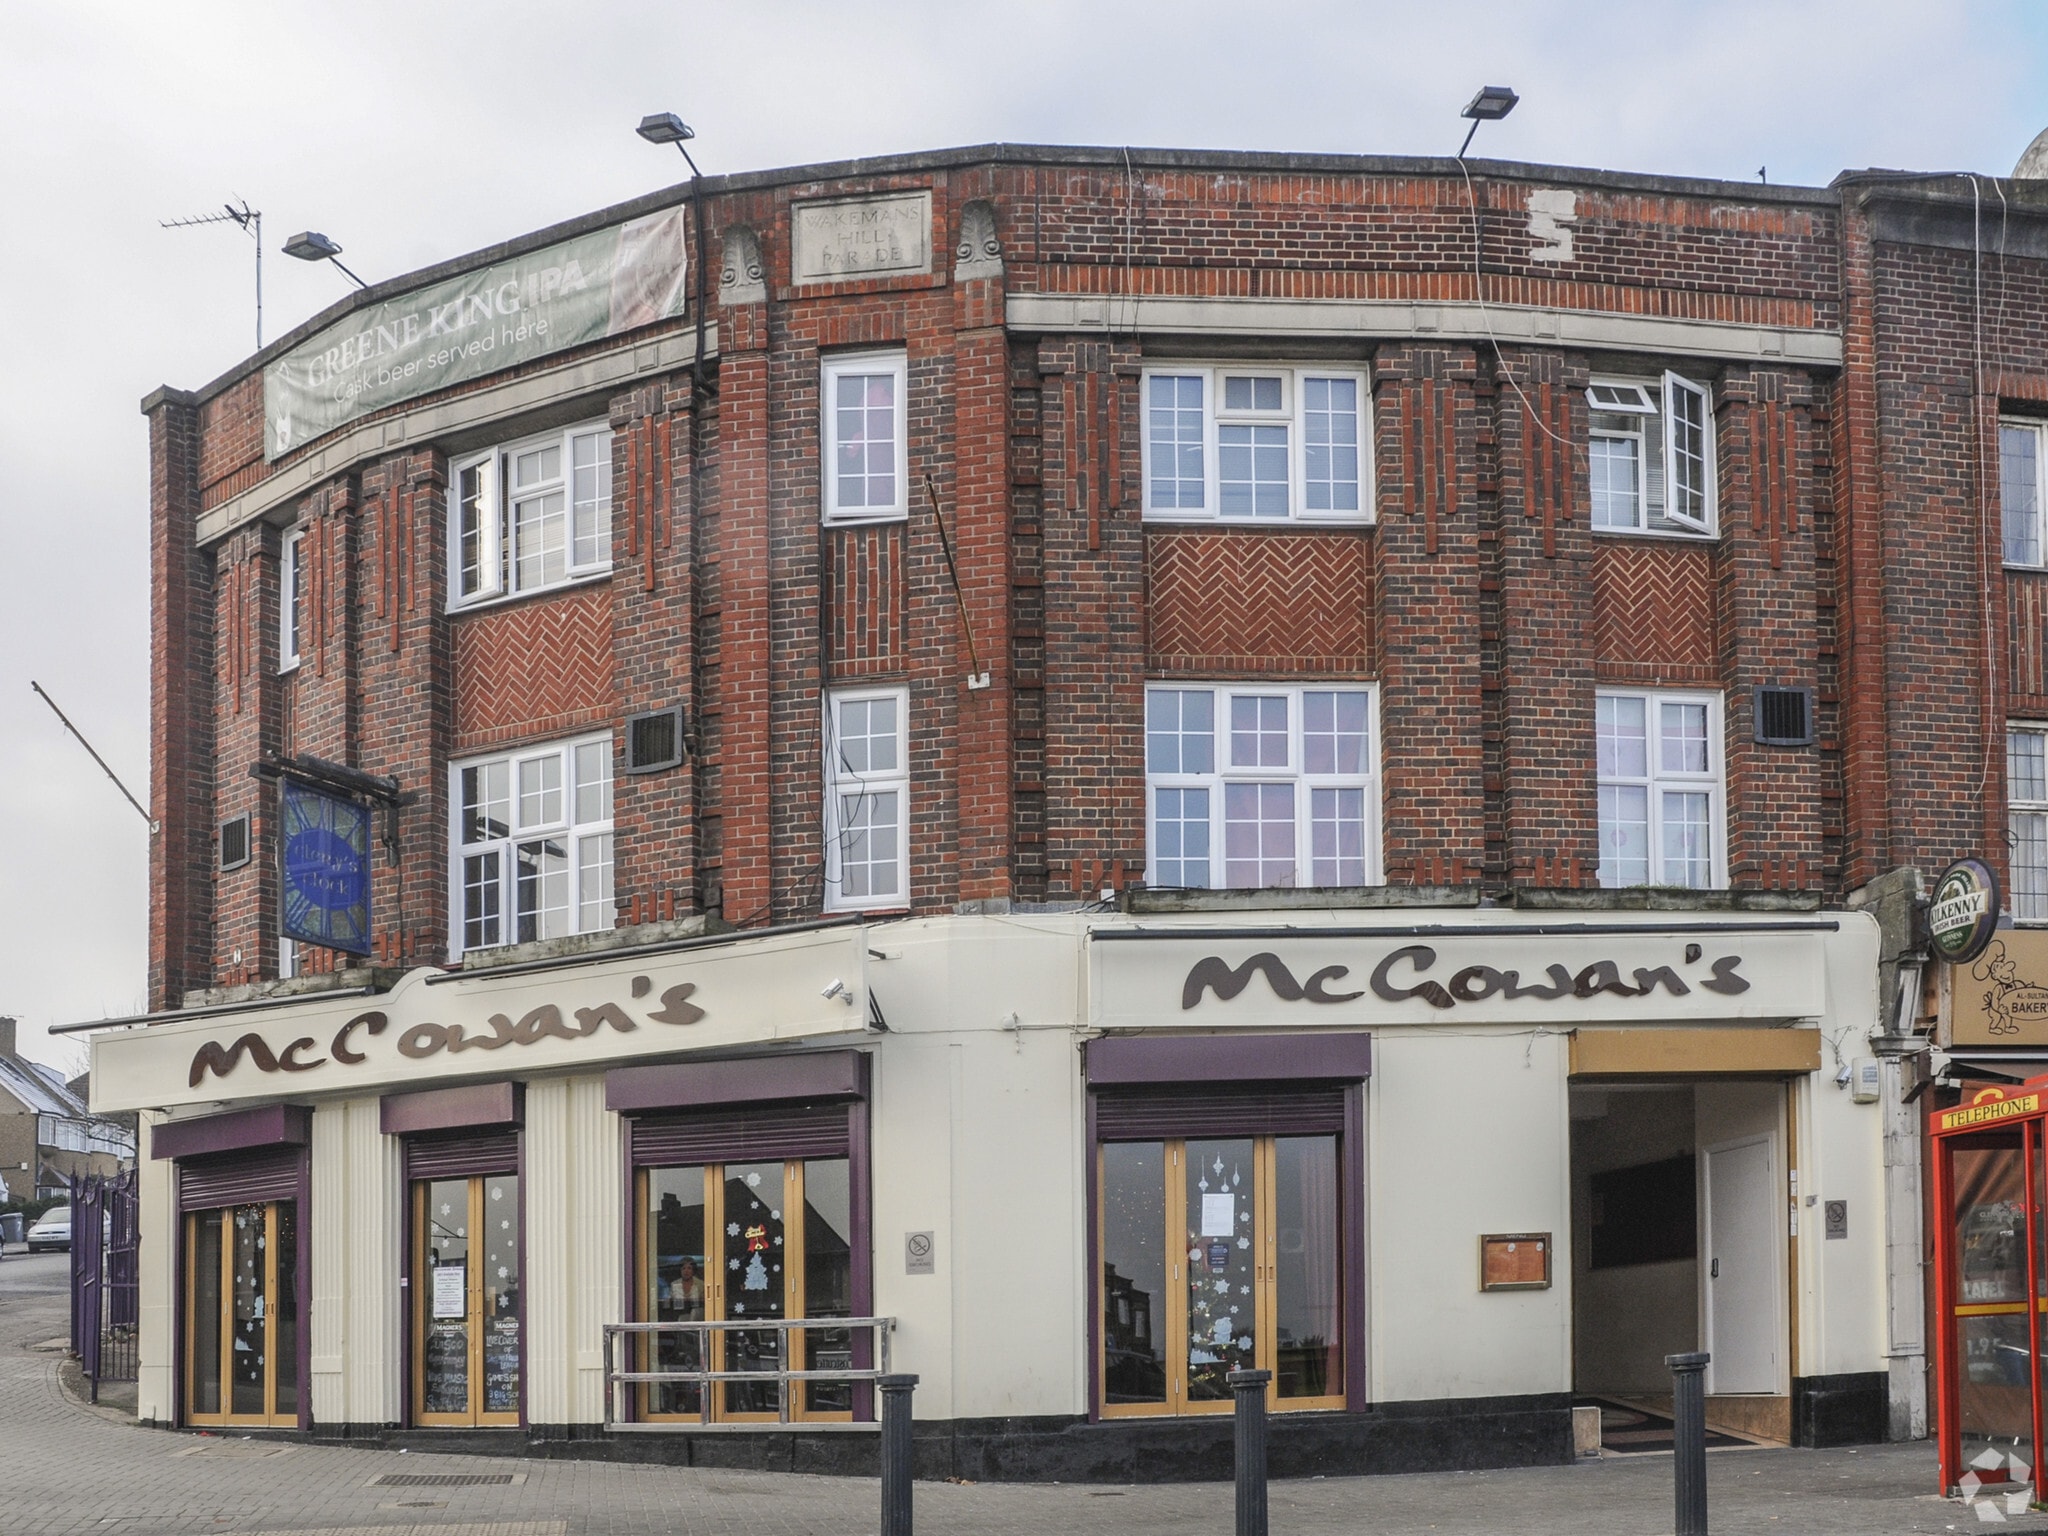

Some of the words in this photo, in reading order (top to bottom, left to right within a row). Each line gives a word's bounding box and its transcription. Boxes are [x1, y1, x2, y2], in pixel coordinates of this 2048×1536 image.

[805, 206, 919, 229] WAKEMANS
[838, 230, 884, 246] HILL
[822, 247, 902, 267] PARADE
[307, 313, 421, 388] GREENE
[427, 281, 521, 338] KING
[528, 260, 587, 308] IPA
[333, 371, 374, 404] Cask
[378, 354, 420, 386] beer
[426, 327, 496, 369] served
[501, 318, 549, 346] here
[1931, 895, 1982, 924] KILKENNY
[1934, 920, 1949, 932] IRISH
[1951, 915, 1971, 926] BEER
[1182, 943, 1751, 1010] McGowan's
[2012, 1003, 2048, 1013] BAKER
[1948, 1097, 2031, 1127] TELEPHONE
